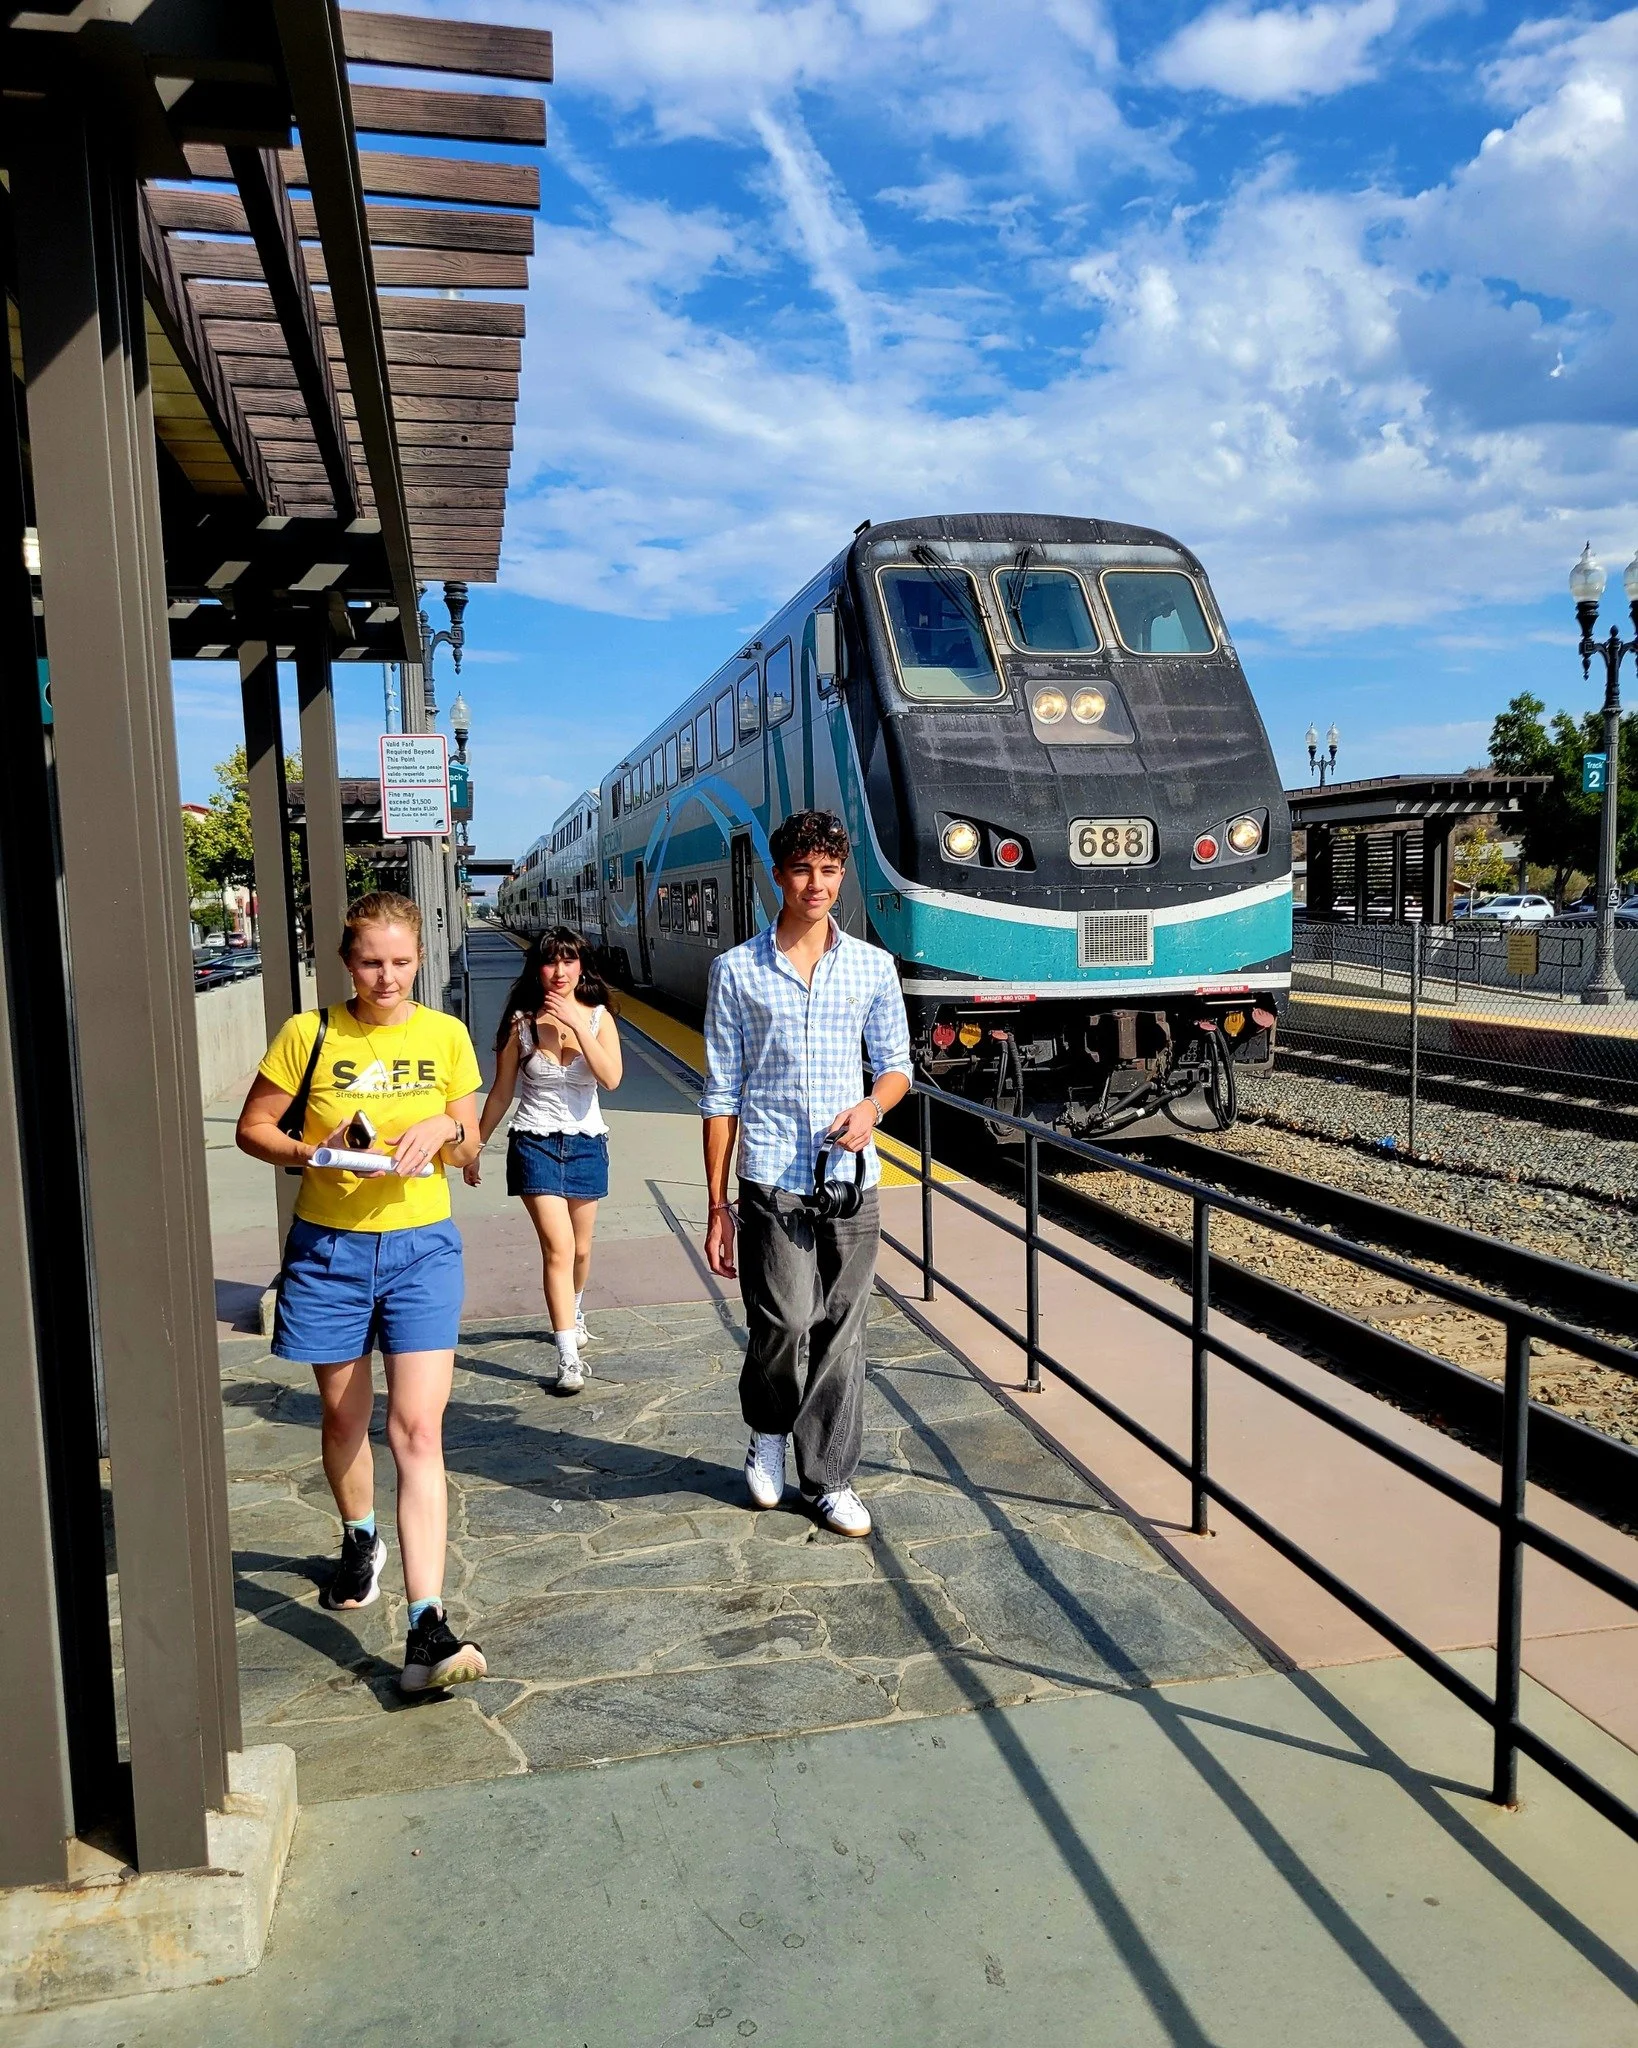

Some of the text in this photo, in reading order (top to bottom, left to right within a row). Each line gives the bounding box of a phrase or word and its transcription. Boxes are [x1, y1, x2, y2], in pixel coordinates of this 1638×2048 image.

[1588, 770, 1600, 787] 2
[451, 784, 457, 802] 1
[1078, 826, 1144, 857] 688
[336, 1091, 364, 1099] Streets
